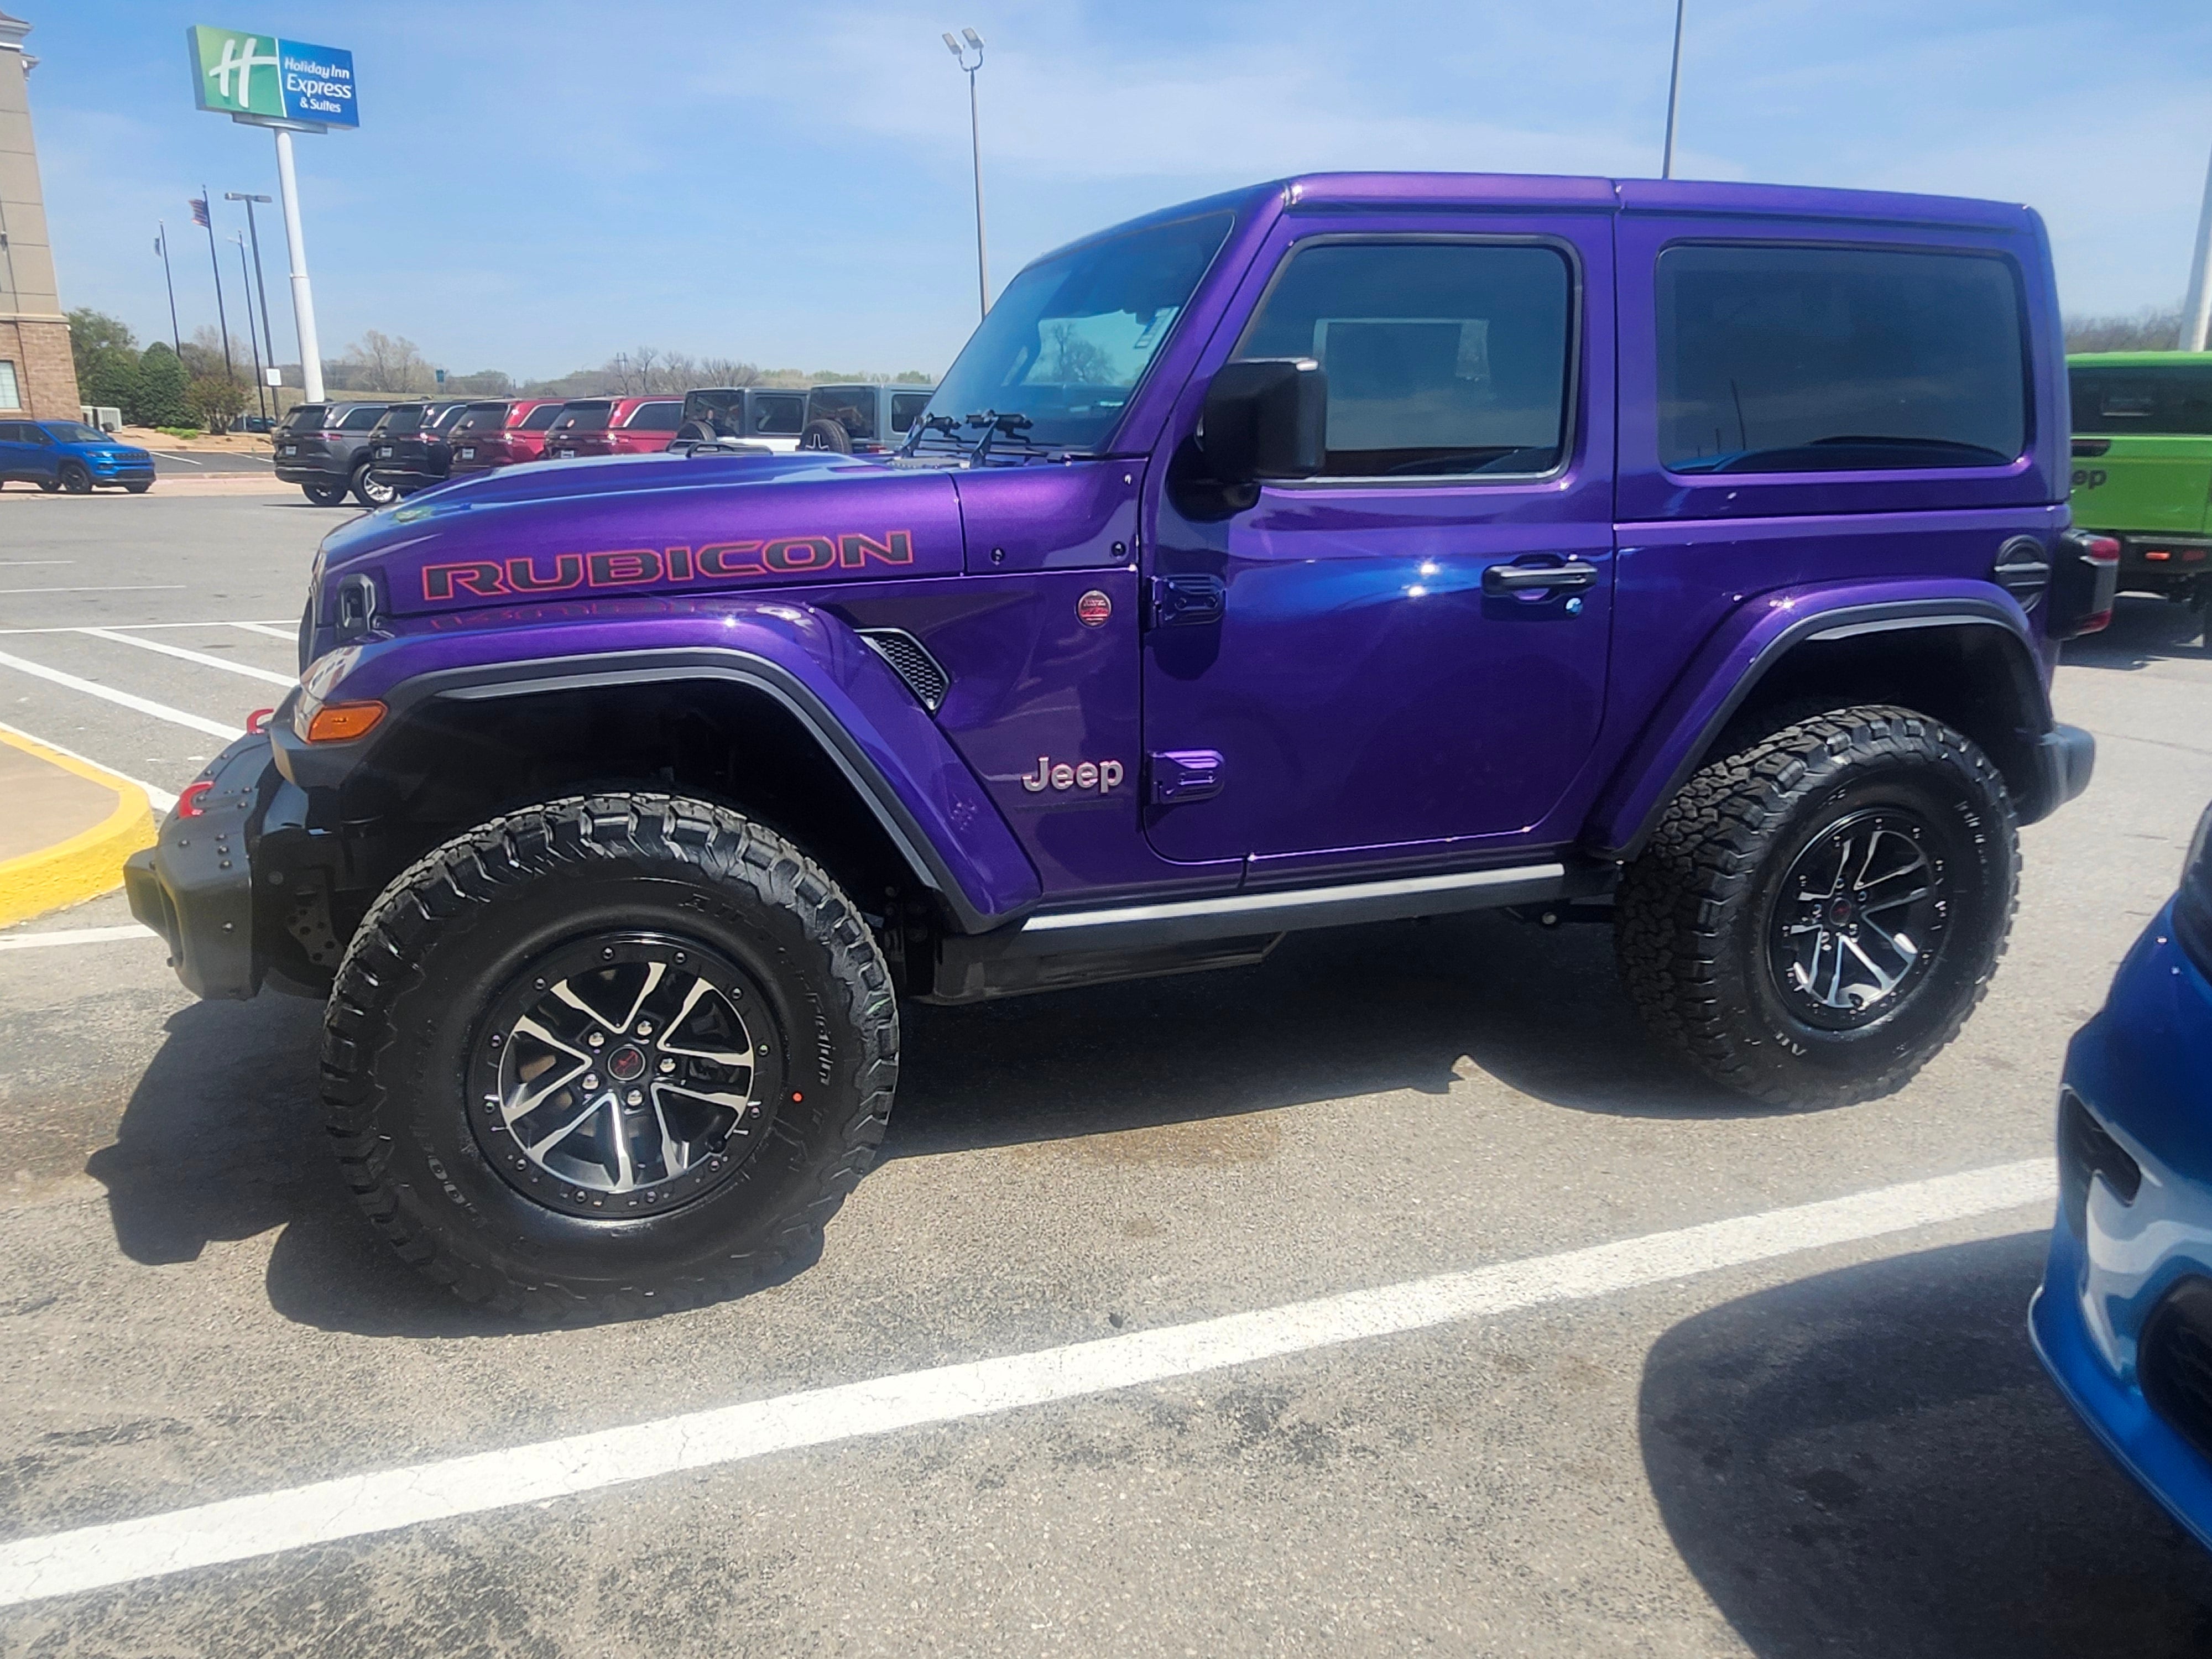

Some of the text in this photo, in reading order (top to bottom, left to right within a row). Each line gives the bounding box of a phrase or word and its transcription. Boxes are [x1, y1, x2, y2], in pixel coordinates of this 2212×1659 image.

[285, 57, 349, 79] Holiday Inn
[287, 73, 352, 98] Express
[300, 96, 341, 113] & Suites
[2072, 469, 2107, 490] ep
[422, 530, 914, 601] RUBICON
[1022, 756, 1124, 793] Jeep
